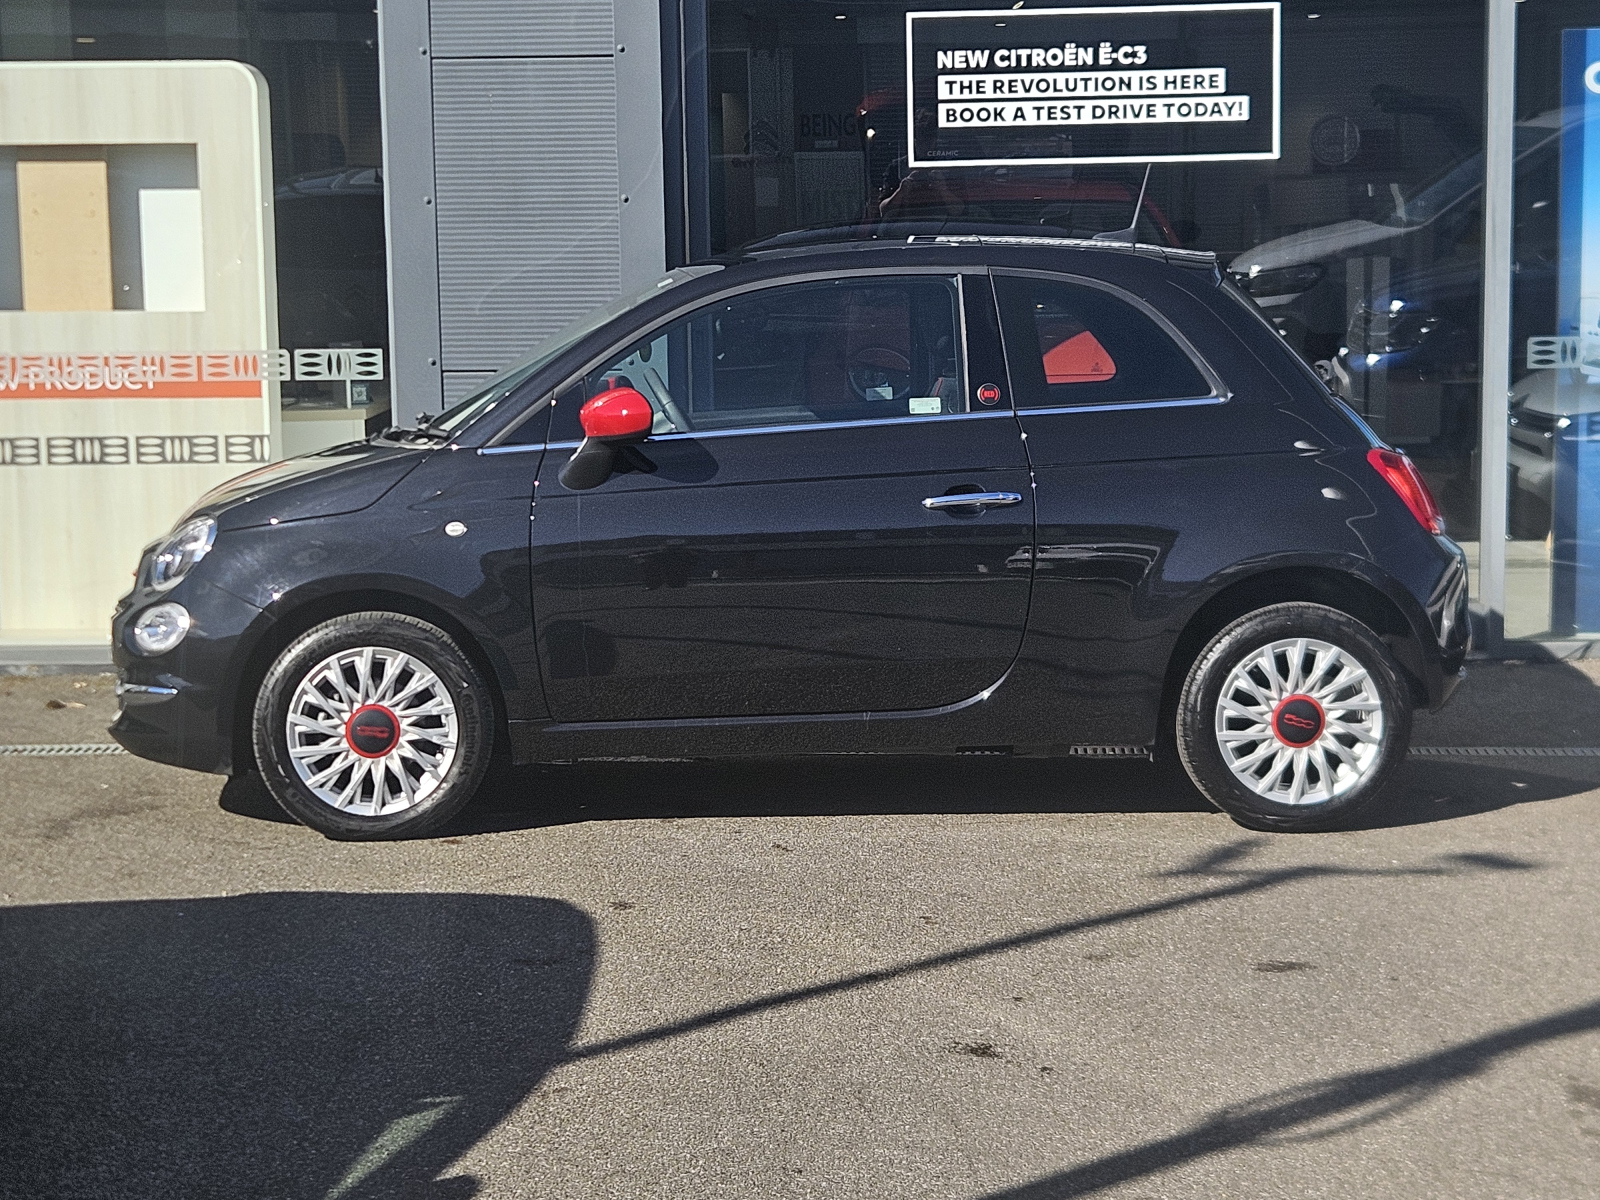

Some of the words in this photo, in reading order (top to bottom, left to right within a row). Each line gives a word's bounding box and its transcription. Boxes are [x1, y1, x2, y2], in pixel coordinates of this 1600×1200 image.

[937, 49, 990, 69] NEW
[993, 43, 1094, 68] CITROËN
[1098, 42, 1148, 65] Ë-C3
[944, 80, 986, 95] THE
[993, 76, 1132, 94] REVOLUTION
[1139, 75, 1158, 91] IS
[1164, 74, 1219, 90] HERE
[945, 107, 1006, 123] BOOK
[1012, 106, 1026, 122] A
[1032, 105, 1086, 121] TEST
[1092, 103, 1157, 120] DRIVE
[1162, 101, 1243, 118] TODAY!
[28, 365, 158, 391] PRODUCT
